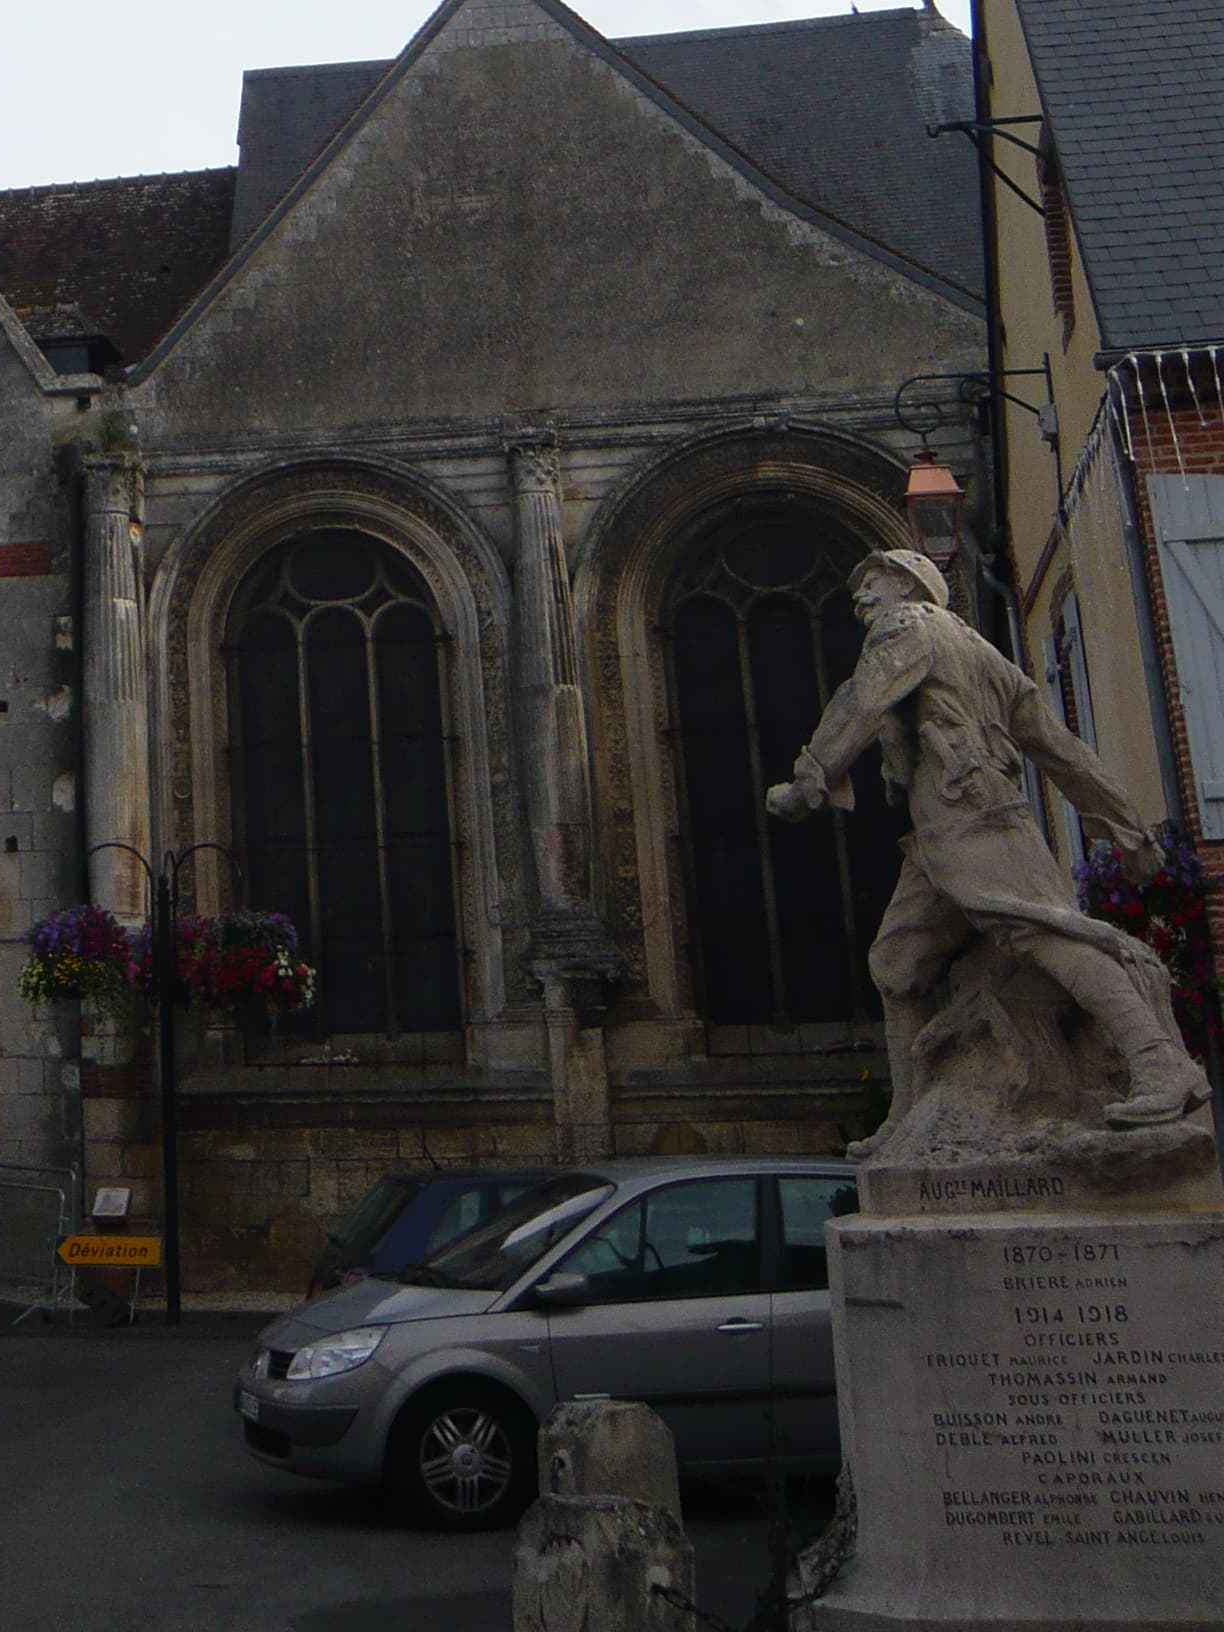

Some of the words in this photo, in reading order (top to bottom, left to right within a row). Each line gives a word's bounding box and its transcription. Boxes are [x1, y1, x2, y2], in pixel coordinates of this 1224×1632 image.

[971, 1176, 1064, 1198] MAILLARD
[68, 1242, 149, 1258] Déviation
[1075, 1276, 1128, 1289] ADRIEN
[1015, 1305, 1064, 1324] 1914
[1078, 1305, 1129, 1323] 1918
[1024, 1332, 1119, 1347] OFFICIERS
[1009, 1354, 1067, 1366] MAURICE
[1093, 1351, 1163, 1366] JARDIN
[988, 1372, 1097, 1387] THOMASSIN
[1107, 1373, 1167, 1385] ARMAND
[1008, 1394, 1049, 1406] SOUS
[1059, 1393, 1146, 1406] OFFICIERS
[934, 1412, 1008, 1427] BUISSON
[1099, 1410, 1188, 1425] DAGUENET
[1001, 1433, 1058, 1445] ALFRED
[1102, 1430, 1177, 1445] MULLER
[1022, 1450, 1095, 1465] PAOLINI
[1038, 1472, 1145, 1485] CAPORAUX
[944, 1491, 1032, 1506] BELLANGER
[1110, 1489, 1190, 1504] CHAUVIN
[946, 1511, 1035, 1527] DUGOMBERT
[1113, 1509, 1201, 1525] GABILLARD
[1002, 1530, 1053, 1546] REVEL
[1065, 1531, 1111, 1545] SAINT
